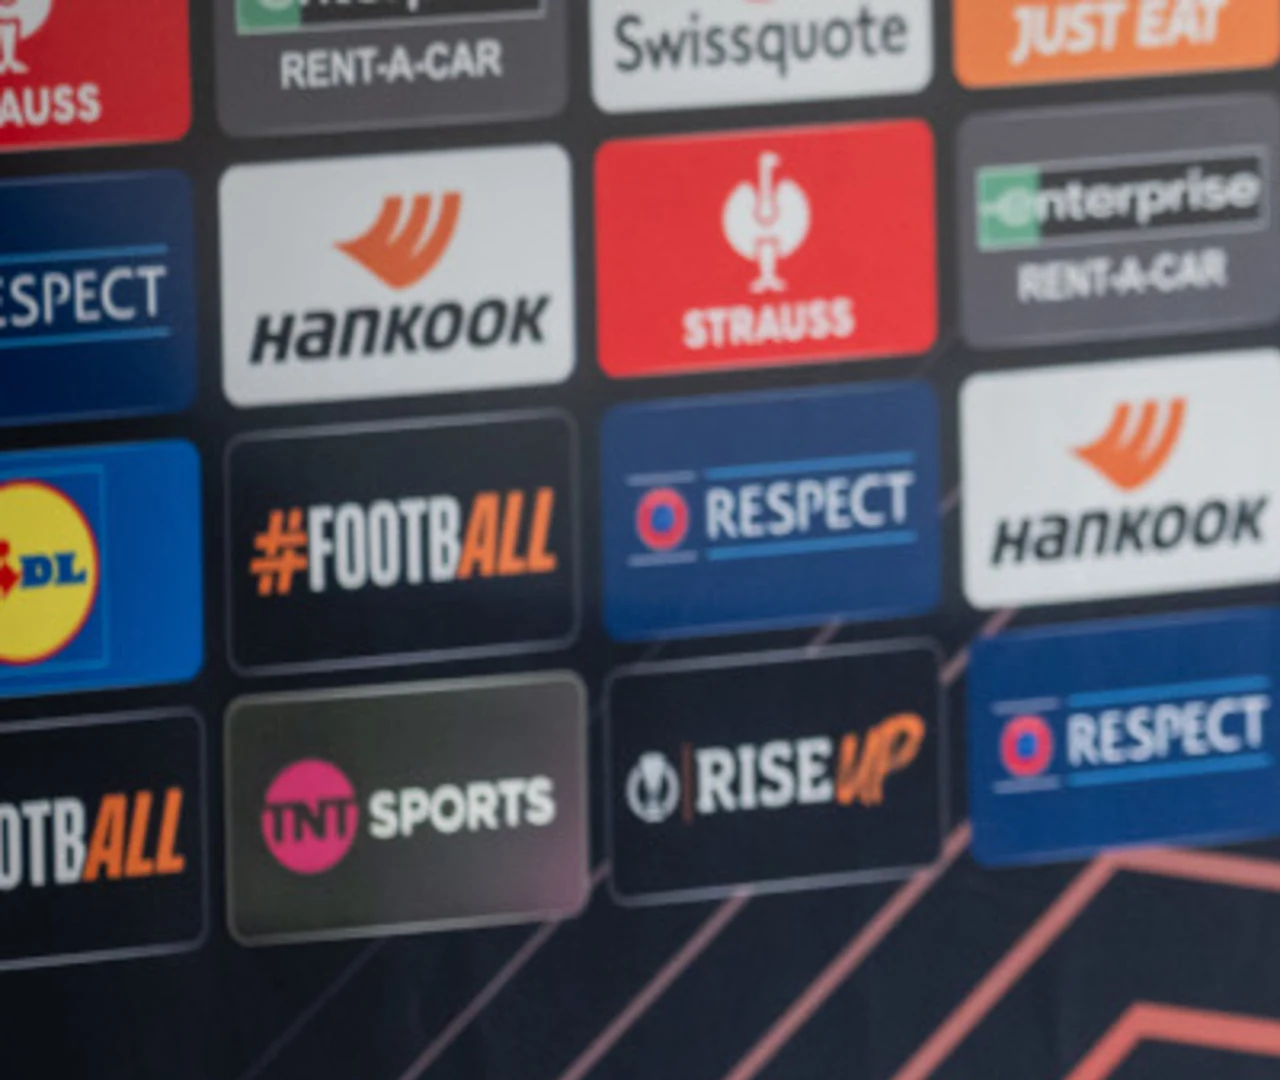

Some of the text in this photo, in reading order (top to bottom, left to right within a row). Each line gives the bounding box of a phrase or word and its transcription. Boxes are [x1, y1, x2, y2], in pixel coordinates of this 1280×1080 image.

[279, 39, 504, 90] RENT-A-CAR
[613, 13, 908, 77] Swissquote
[1008, 0, 1232, 66] JUST EAT
[0, 83, 102, 127] AUSS
[981, 166, 1261, 226] enterprise
[0, 265, 168, 327] SPECT
[1016, 246, 1229, 303] RENT-A-CAR
[682, 298, 855, 349] STRAUSS
[705, 472, 915, 540] RESPECT
[250, 486, 558, 596] #FOOTBALL
[1067, 696, 1271, 767] RESPECT
[0, 785, 187, 892] OTBALL
[265, 774, 557, 846] TNT SPORTS
